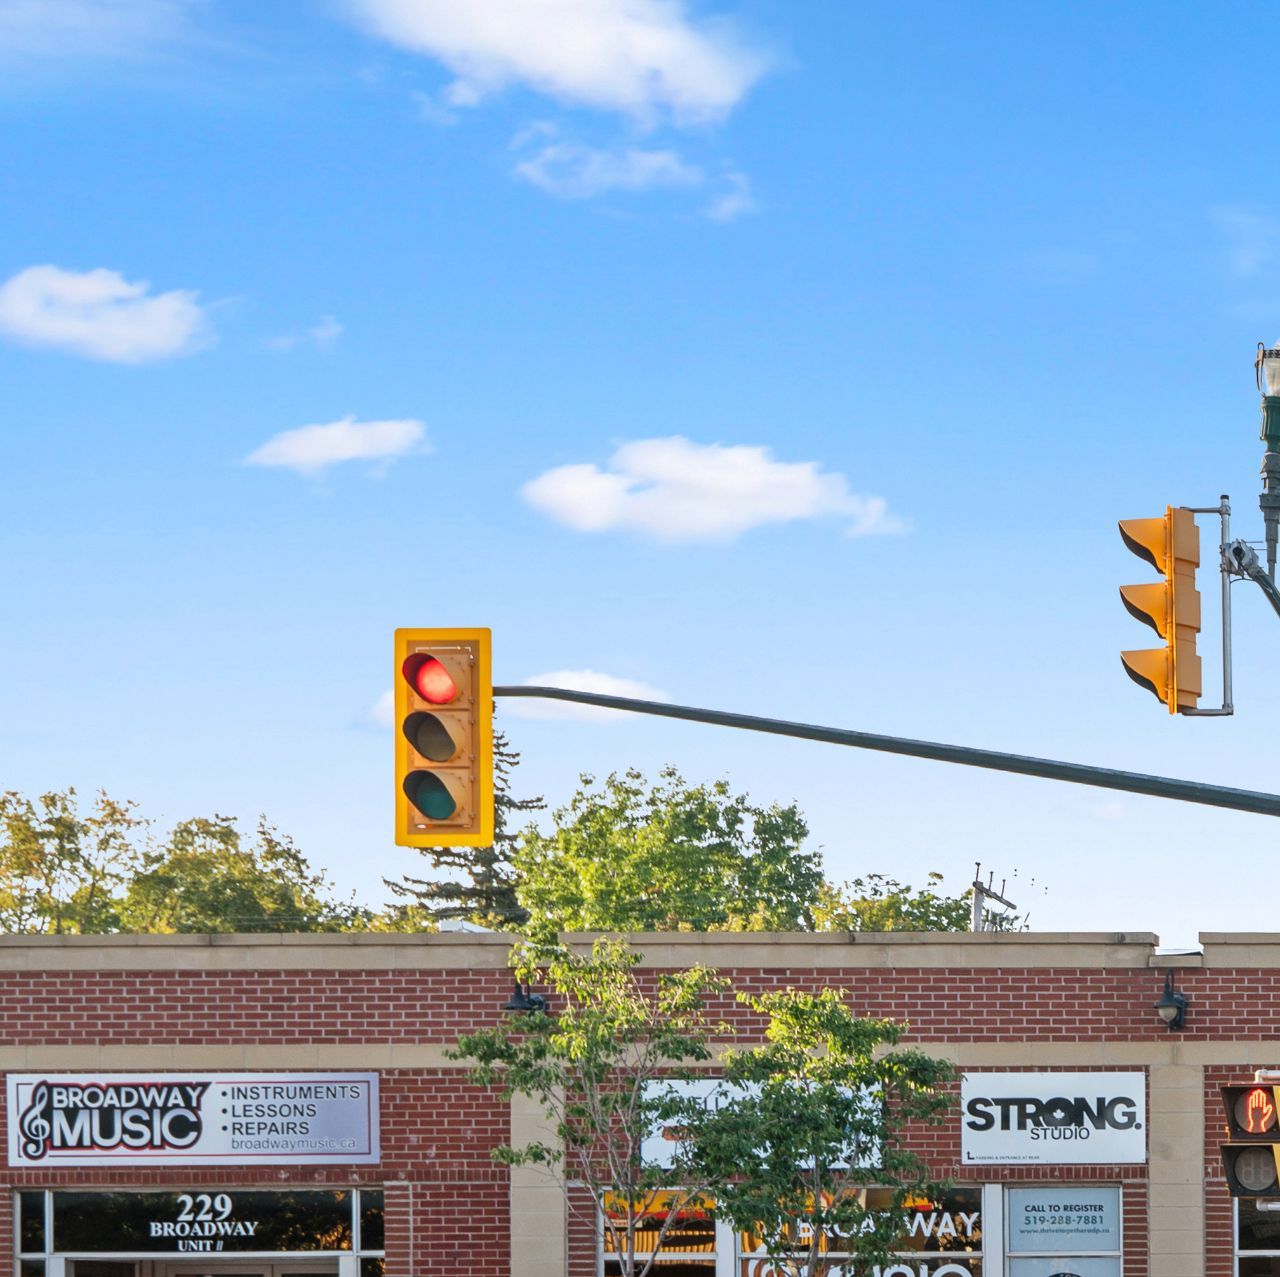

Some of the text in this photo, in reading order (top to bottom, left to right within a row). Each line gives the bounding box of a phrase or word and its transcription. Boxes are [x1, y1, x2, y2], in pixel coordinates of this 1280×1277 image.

[53, 1086, 204, 1109] BROADWAY
[231, 1085, 361, 1100] INSTRUMENTS
[231, 1103, 318, 1119] LESSONS
[52, 1108, 200, 1148] MUSIC
[231, 1121, 311, 1136] REPAIRS
[1030, 1127, 1090, 1140] STUDIO
[231, 1136, 357, 1152] broadwaymusic.ca
[176, 1193, 233, 1222] 229
[1024, 1204, 1104, 1213] CALL TO REGISTER
[796, 1212, 980, 1238] BROAWAY
[1024, 1215, 1104, 1225] 519-288-7881
[150, 1221, 259, 1237] BROADWAY
[178, 1240, 214, 1251] UNIT
